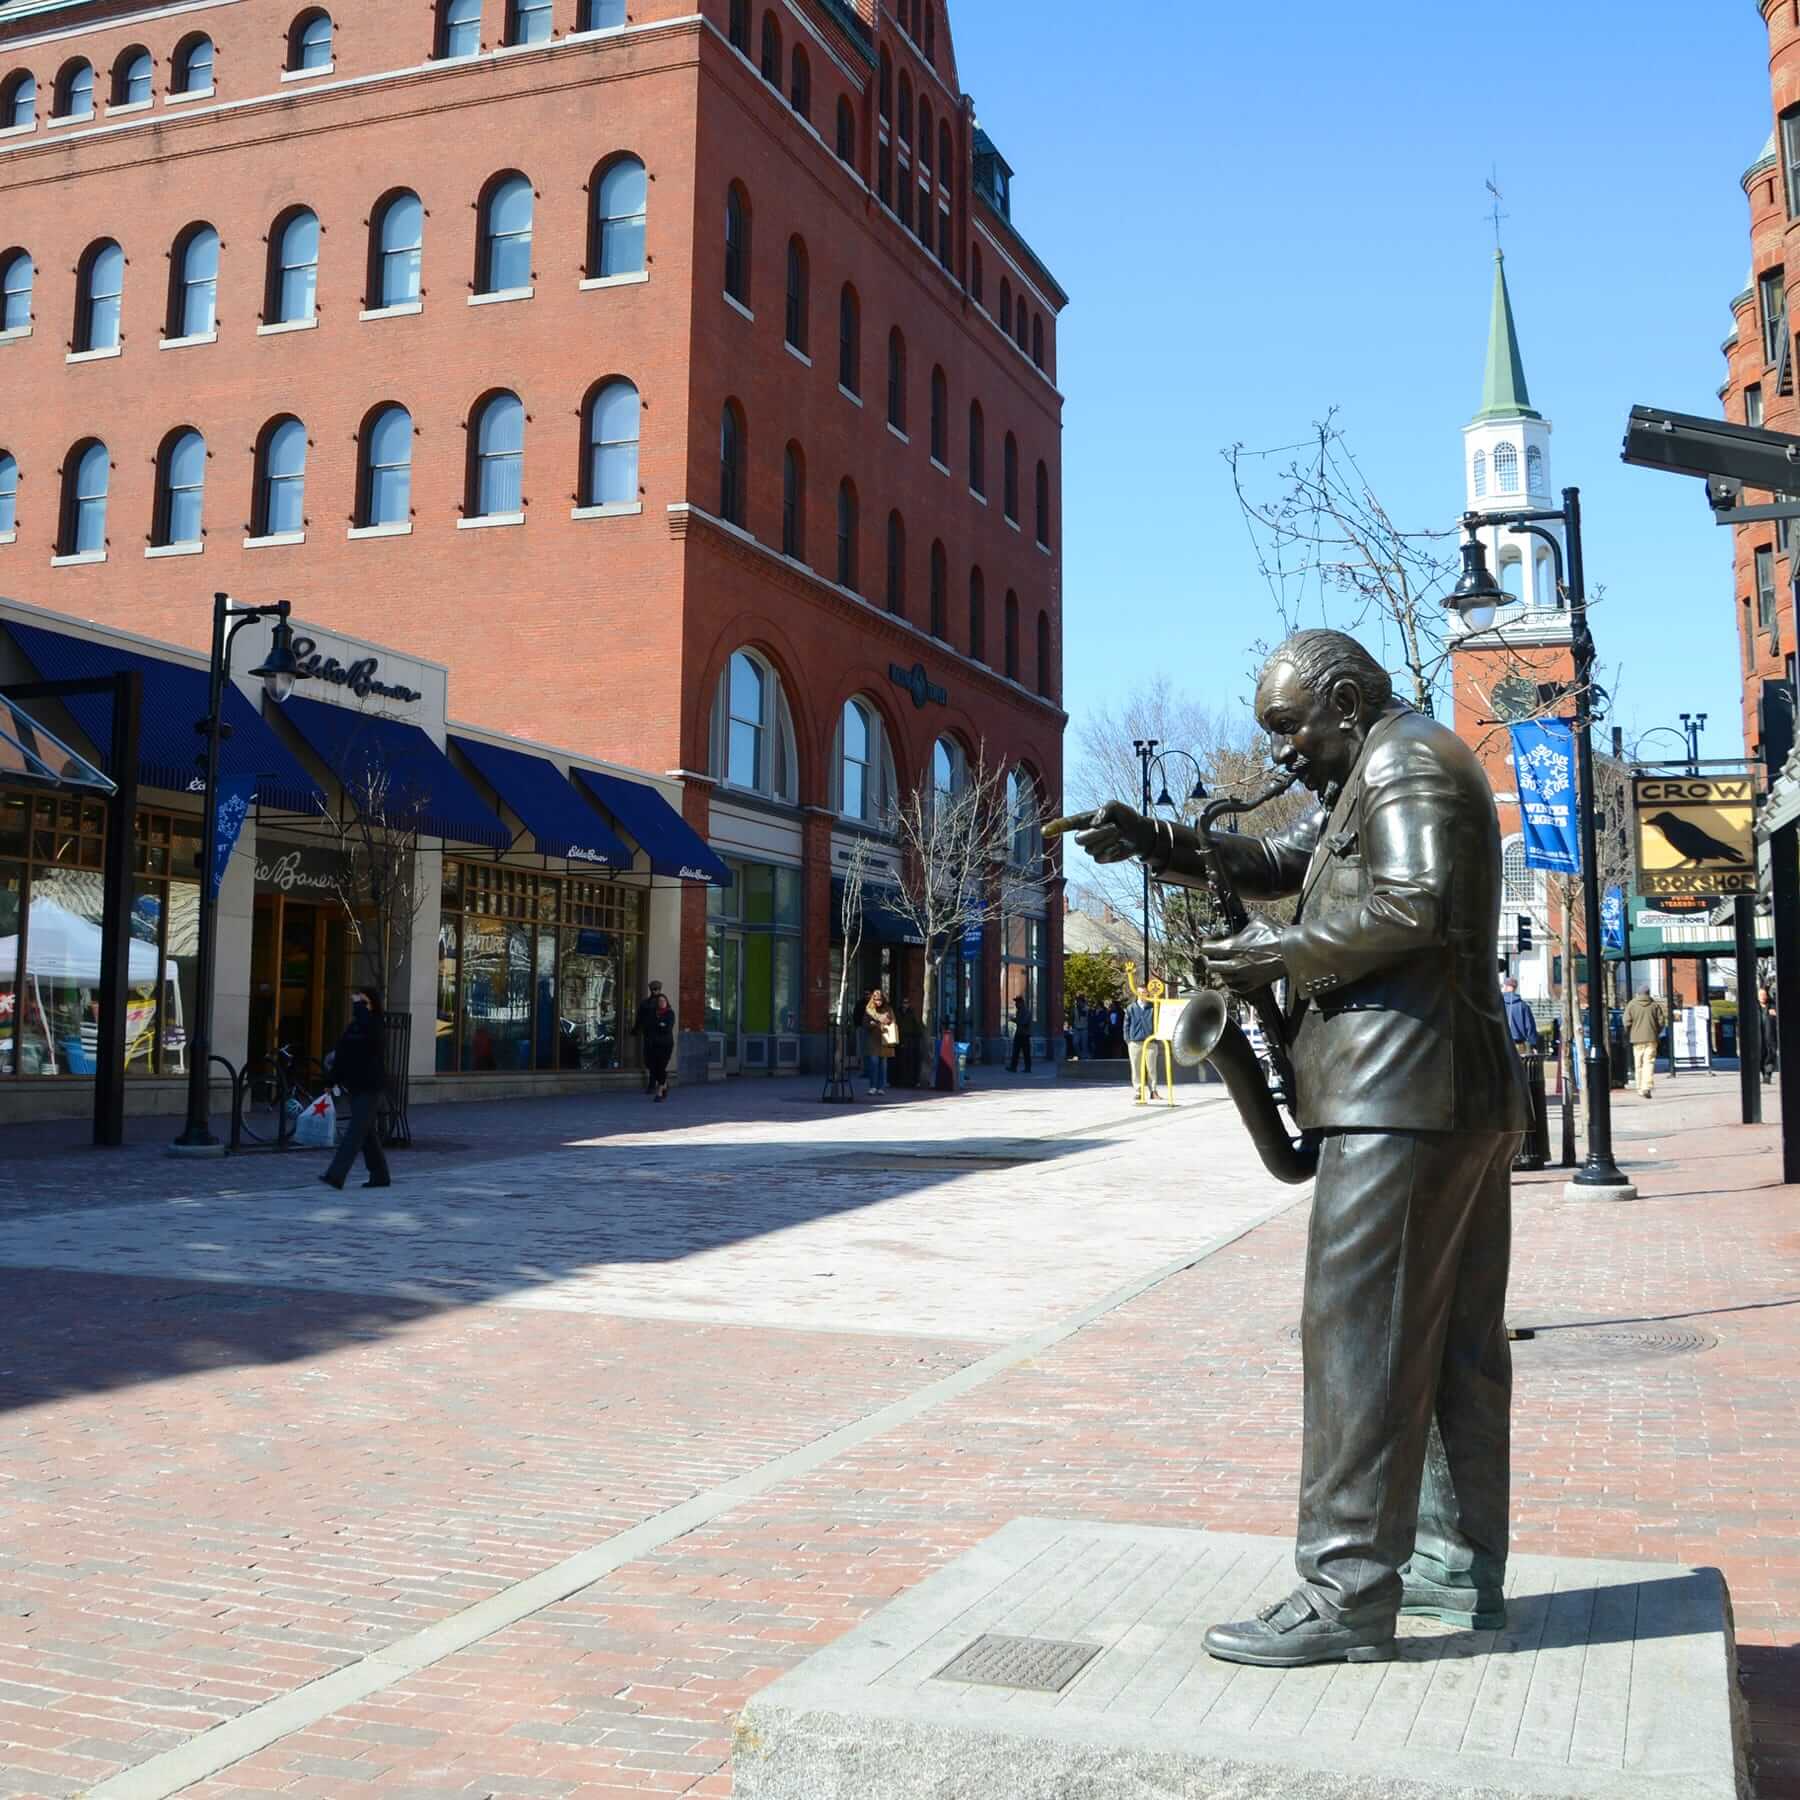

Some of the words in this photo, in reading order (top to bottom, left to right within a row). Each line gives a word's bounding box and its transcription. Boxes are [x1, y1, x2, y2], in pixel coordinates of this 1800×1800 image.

[1641, 782, 1747, 799] CROW
[1524, 803, 1569, 816] WINTER
[1527, 814, 1568, 827] LIGHTS
[273, 851, 341, 890] Bauer
[1642, 874, 1754, 893] BOOKSHOP
